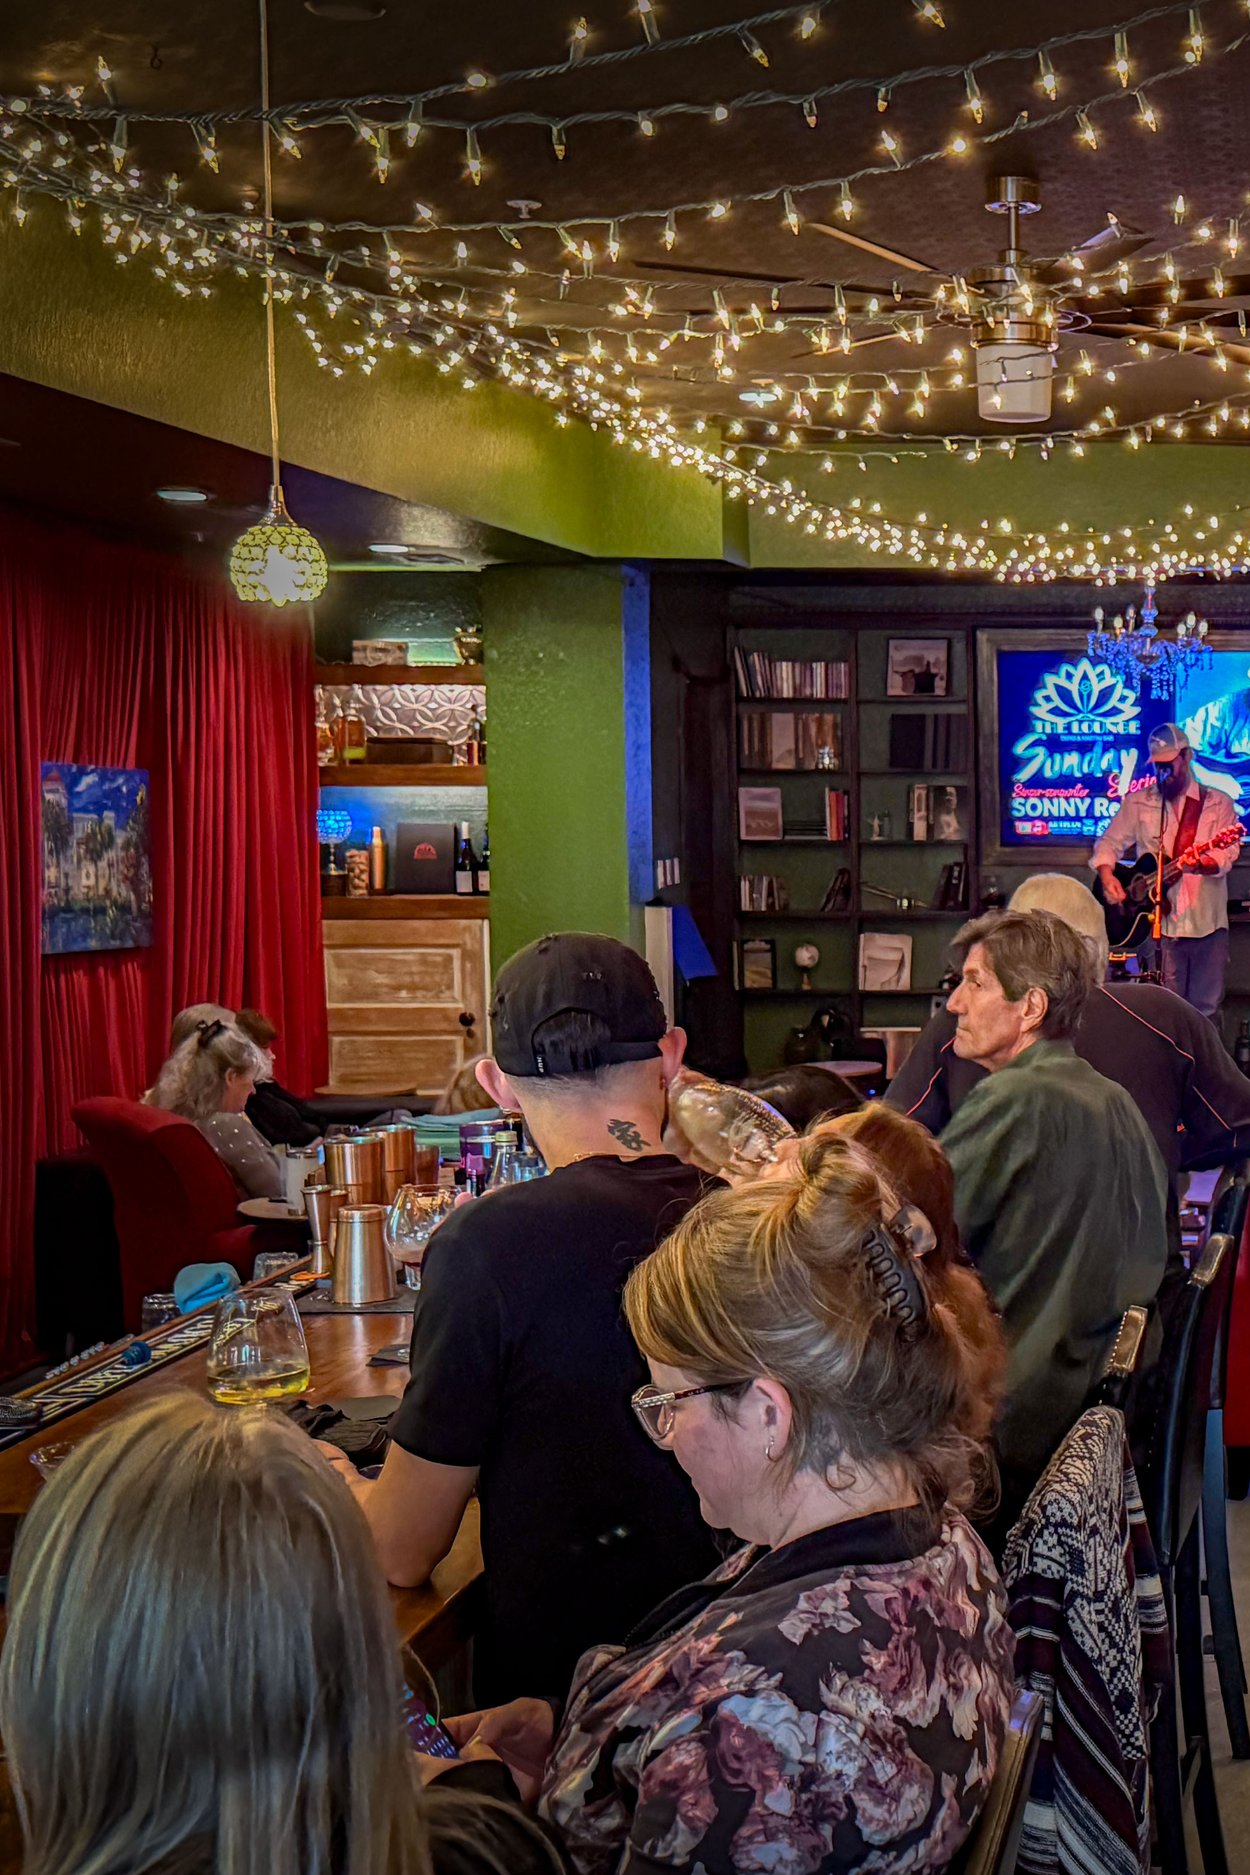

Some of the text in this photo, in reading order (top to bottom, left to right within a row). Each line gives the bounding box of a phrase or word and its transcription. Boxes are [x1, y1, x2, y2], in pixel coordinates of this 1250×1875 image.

[1032, 719, 1141, 735] THE LOUNGE
[1012, 732, 1138, 796] Sunday
[1012, 797, 1091, 817] SONNY
